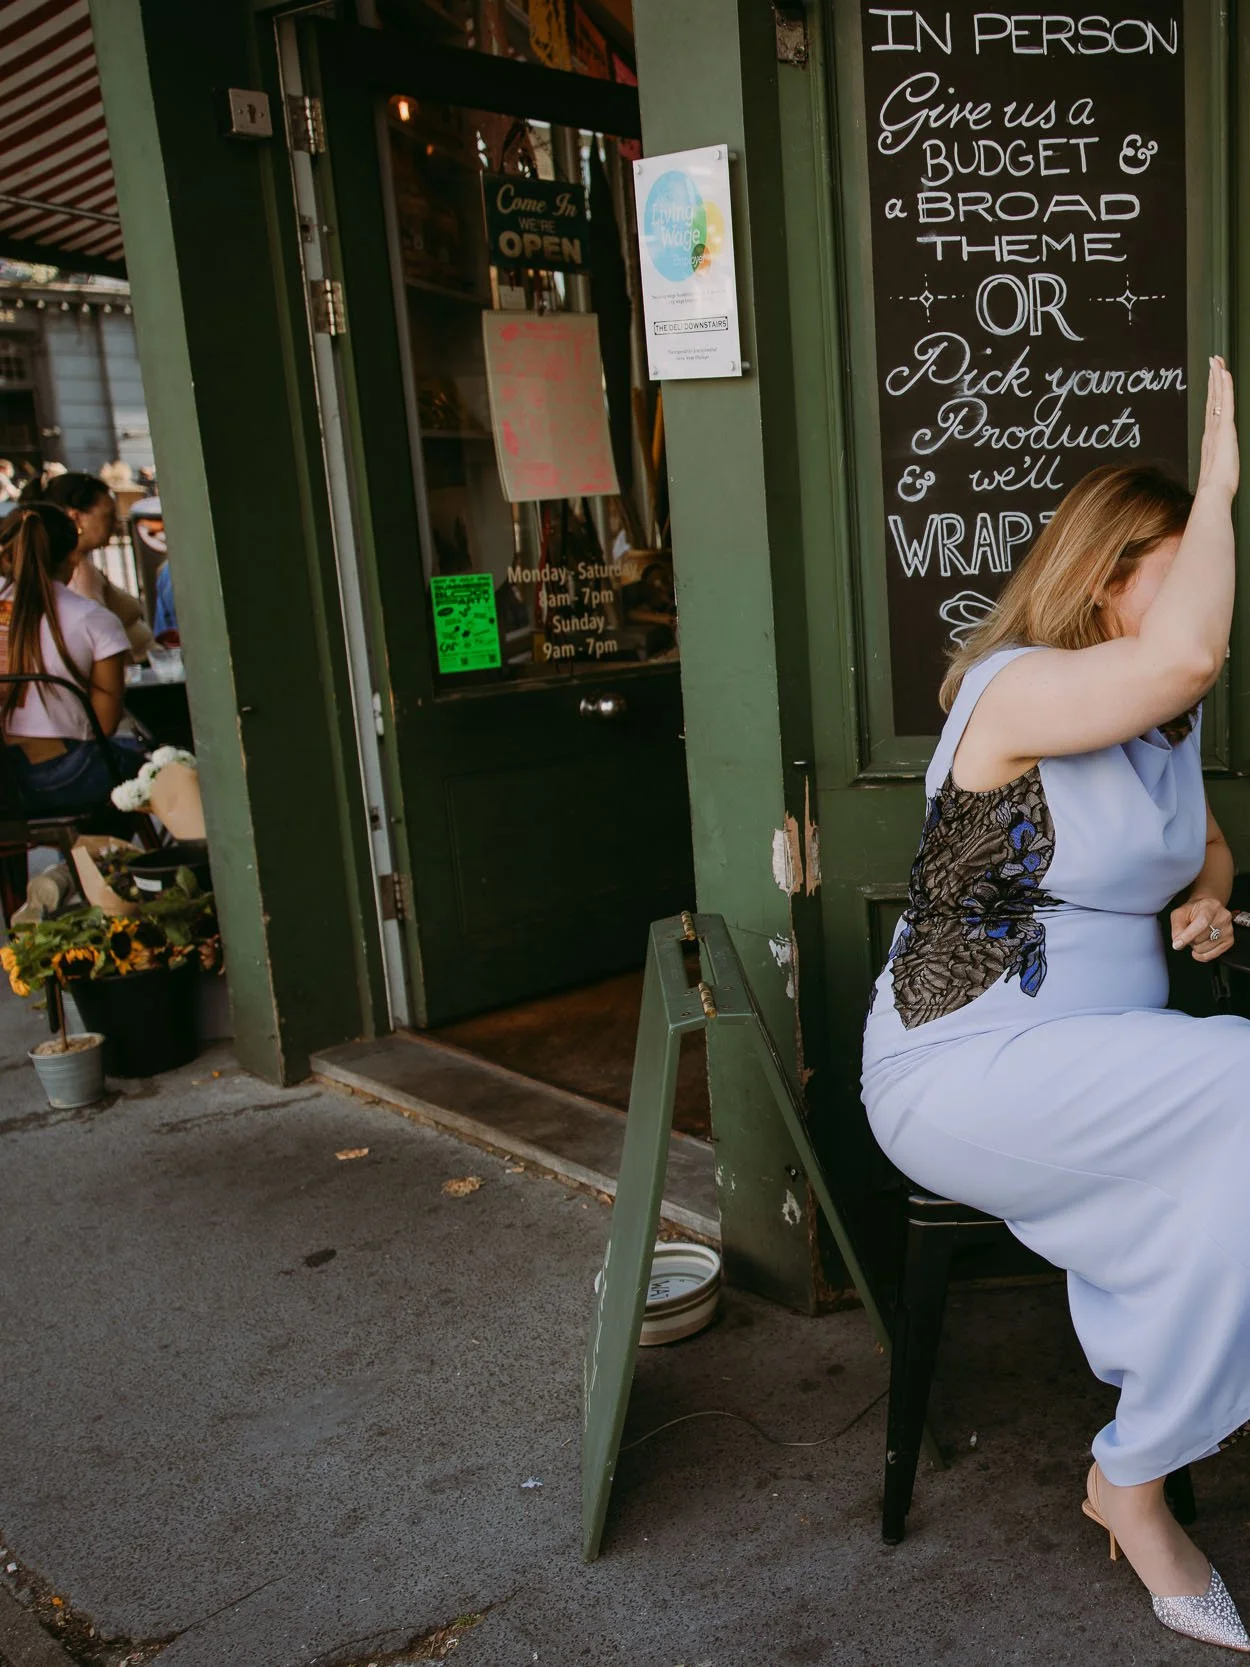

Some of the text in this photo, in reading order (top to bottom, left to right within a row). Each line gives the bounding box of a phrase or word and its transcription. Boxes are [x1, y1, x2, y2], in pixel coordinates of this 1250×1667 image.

[869, 8, 1178, 55] IN PERSON
[877, 71, 1095, 155] Give us a
[920, 133, 1159, 186] BUDGET &
[496, 183, 578, 217] Come In
[651, 201, 695, 226] Living
[885, 192, 1140, 223] a BROAD
[499, 230, 582, 264] OPEN
[660, 226, 701, 252] Wage
[916, 232, 1127, 263] THEME
[975, 273, 1085, 342] OR
[655, 319, 728, 333] THE DELI DOWNSTAIRS
[885, 332, 1033, 397] Pick
[911, 397, 1142, 455] Products
[897, 454, 1064, 503] & we'll
[888, 512, 1033, 578] WRAP
[507, 563, 566, 586] Monday
[577, 561, 638, 580] Saturday
[538, 588, 571, 608] 8am
[581, 586, 614, 609] 7pm
[552, 612, 605, 634] Sunday
[542, 642, 576, 661] 9am
[585, 637, 618, 660] 7pm
